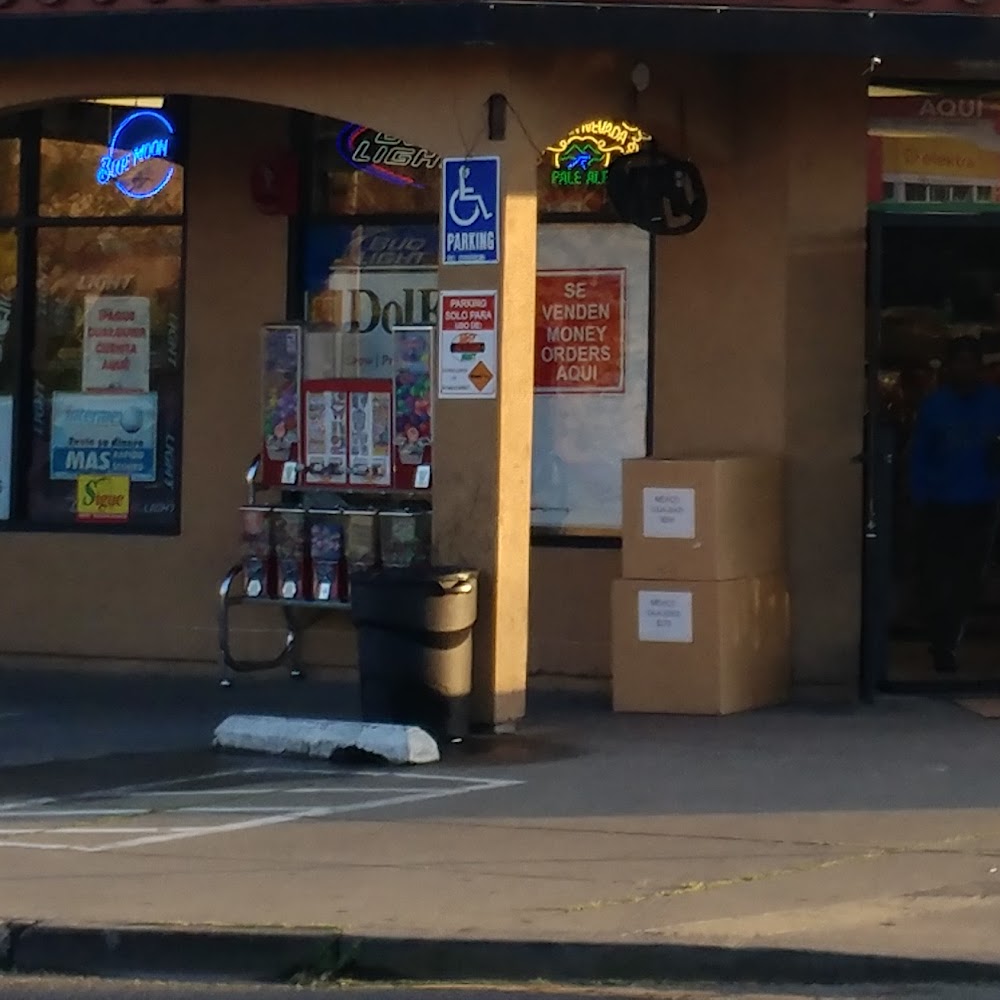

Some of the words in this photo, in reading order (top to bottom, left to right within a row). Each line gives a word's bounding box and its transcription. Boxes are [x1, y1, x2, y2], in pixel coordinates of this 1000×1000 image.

[919, 98, 983, 118] AQUI
[351, 139, 443, 169] LIGH
[550, 169, 582, 185] PALE
[446, 230, 495, 252] PARKING
[563, 281, 587, 299] SE
[450, 298, 487, 309] PARKING
[541, 303, 611, 322] VENDEN
[445, 310, 468, 321] SOLO
[469, 310, 493, 321] PARA
[546, 324, 607, 343] MONEY
[541, 345, 611, 363] ORDERS
[556, 365, 598, 383] AQUI
[65, 450, 112, 470] MAS
